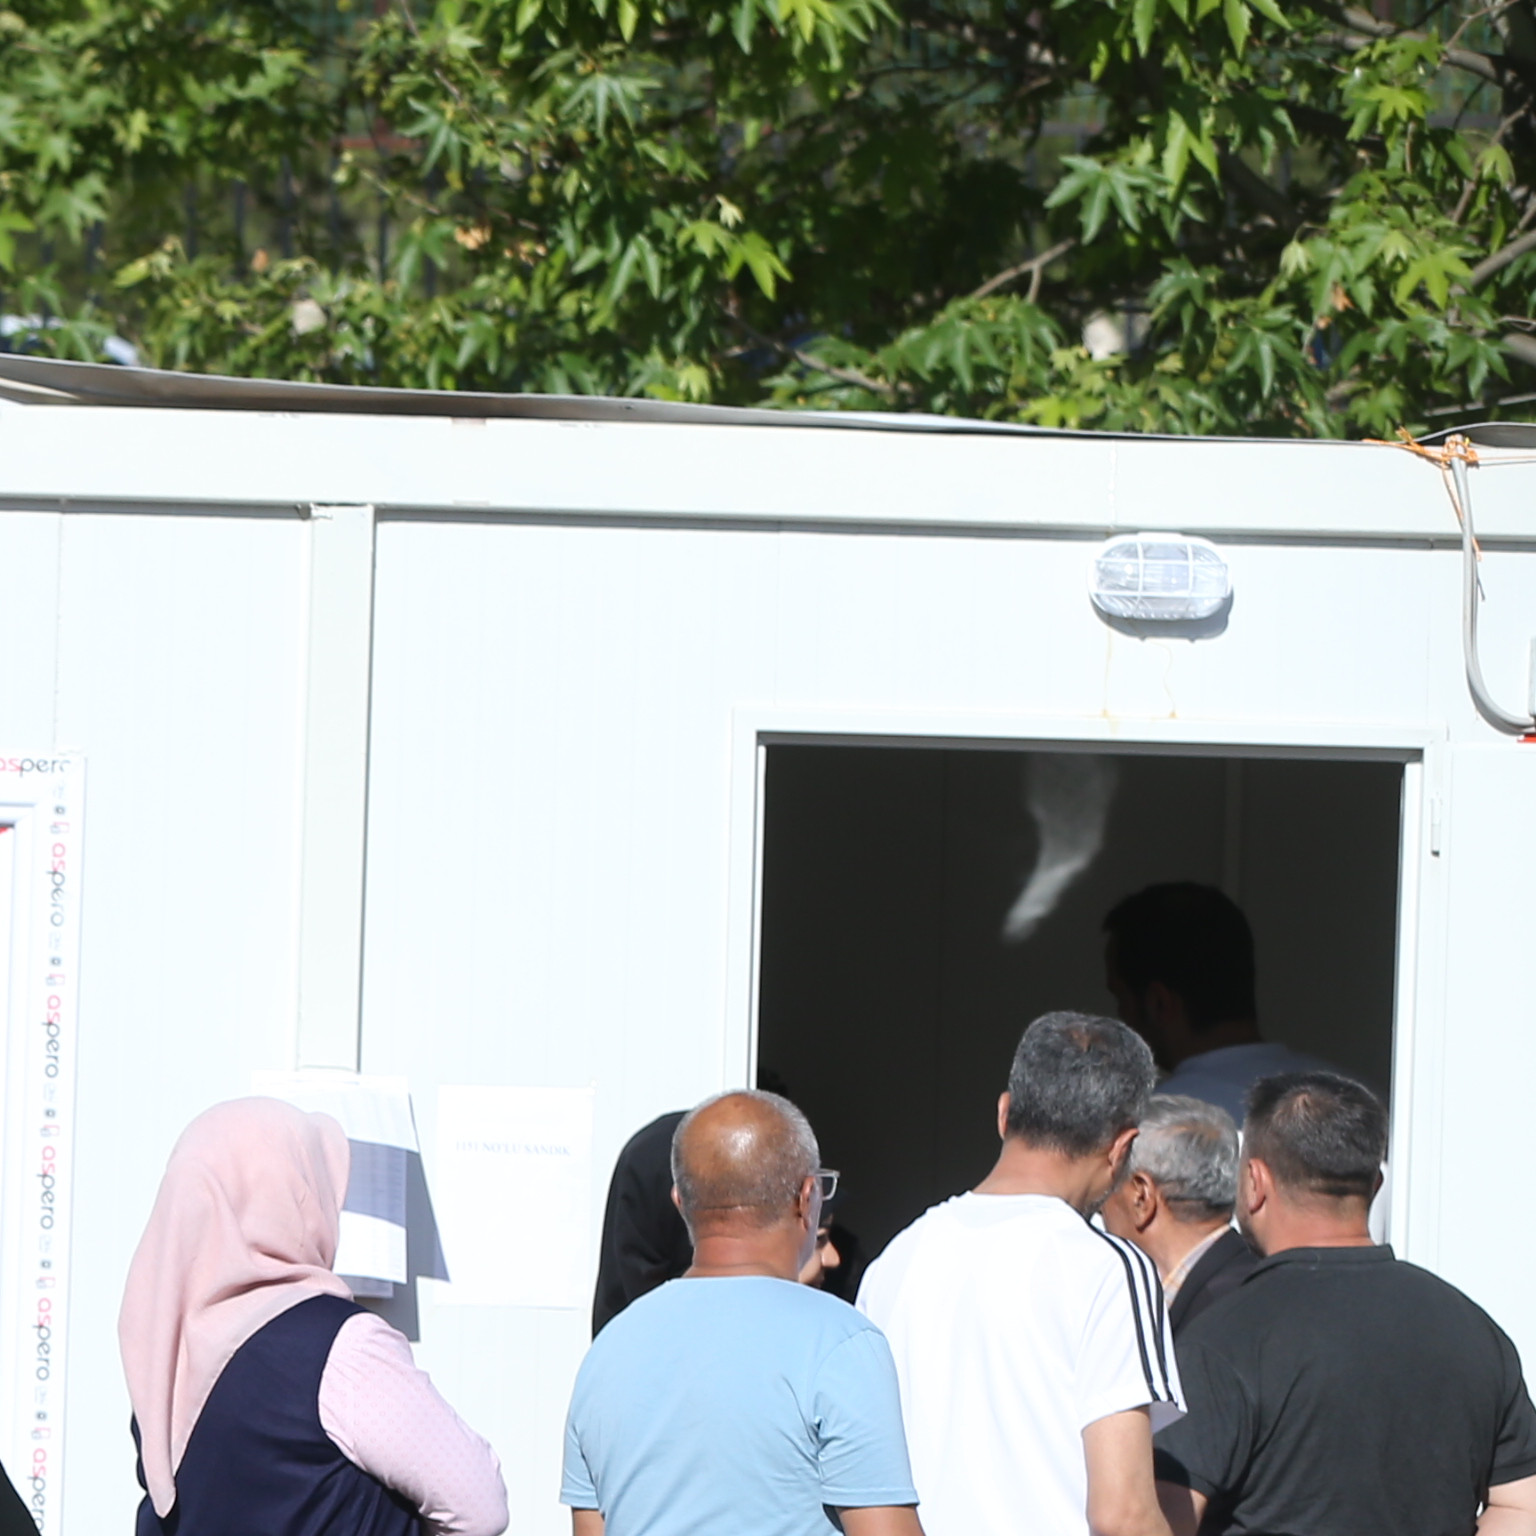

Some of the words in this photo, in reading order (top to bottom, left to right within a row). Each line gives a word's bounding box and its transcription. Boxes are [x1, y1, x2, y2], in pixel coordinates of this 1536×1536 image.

[46, 843, 65, 927] aspero
[42, 995, 60, 1078] aspero
[36, 1146, 55, 1230] aspero
[33, 1298, 51, 1381] aspero
